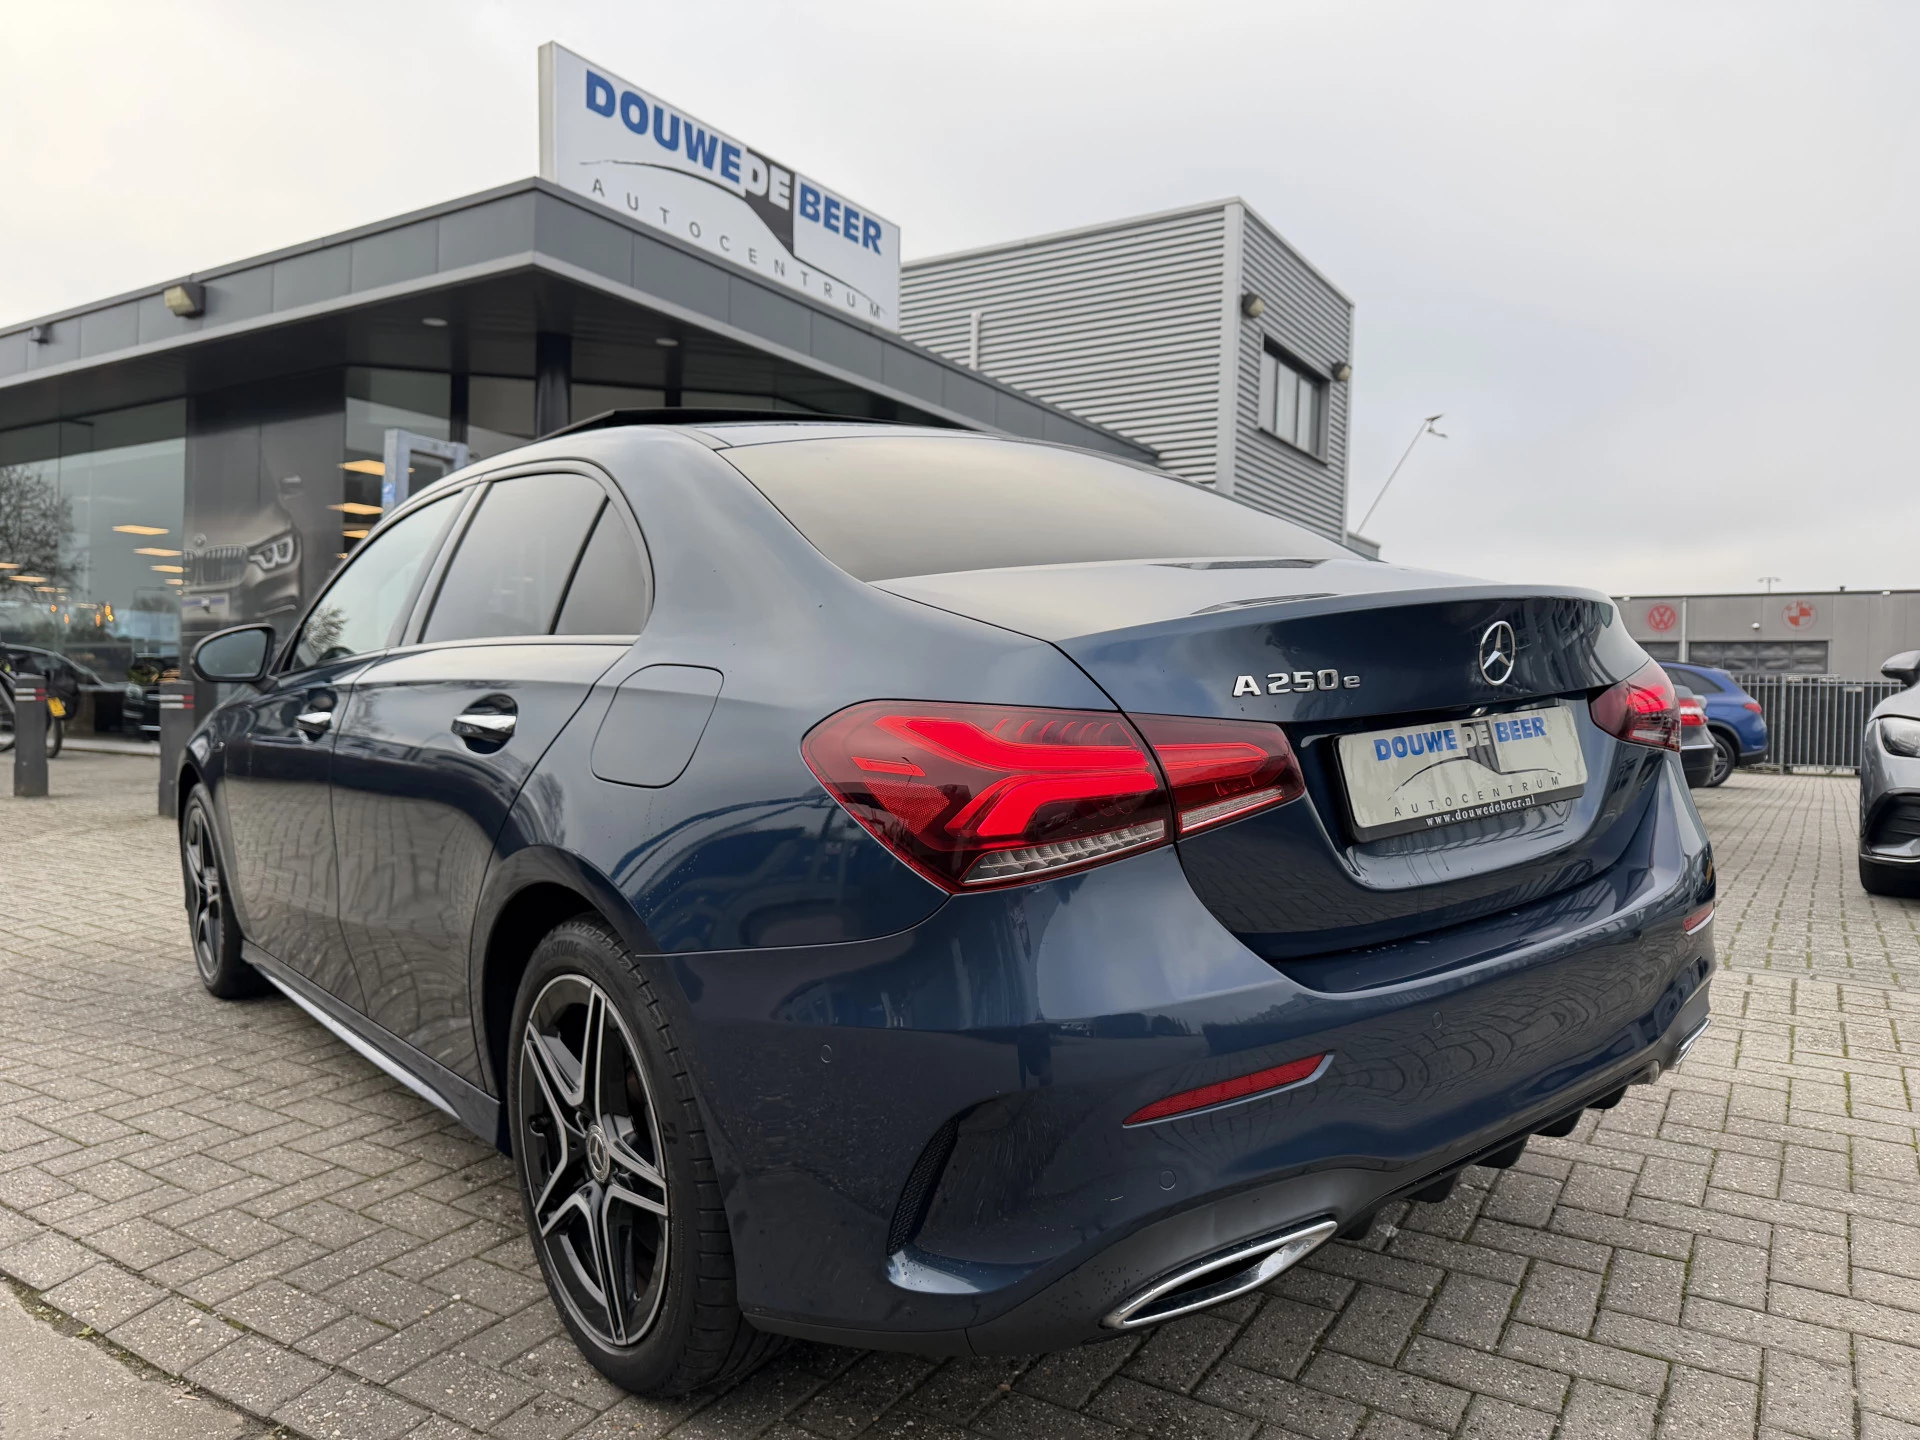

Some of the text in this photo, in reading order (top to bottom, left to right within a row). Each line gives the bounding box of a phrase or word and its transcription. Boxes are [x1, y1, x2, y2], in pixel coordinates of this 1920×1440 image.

[586, 69, 882, 256] DOUWE DE BEER
[591, 178, 882, 320] AUTOCENTRUM
[1373, 716, 1547, 762] DOUWE DE BEER
[1393, 775, 1560, 818] AUTOCENTRUM
[1425, 794, 1536, 827] www.douwedebeer.nl
